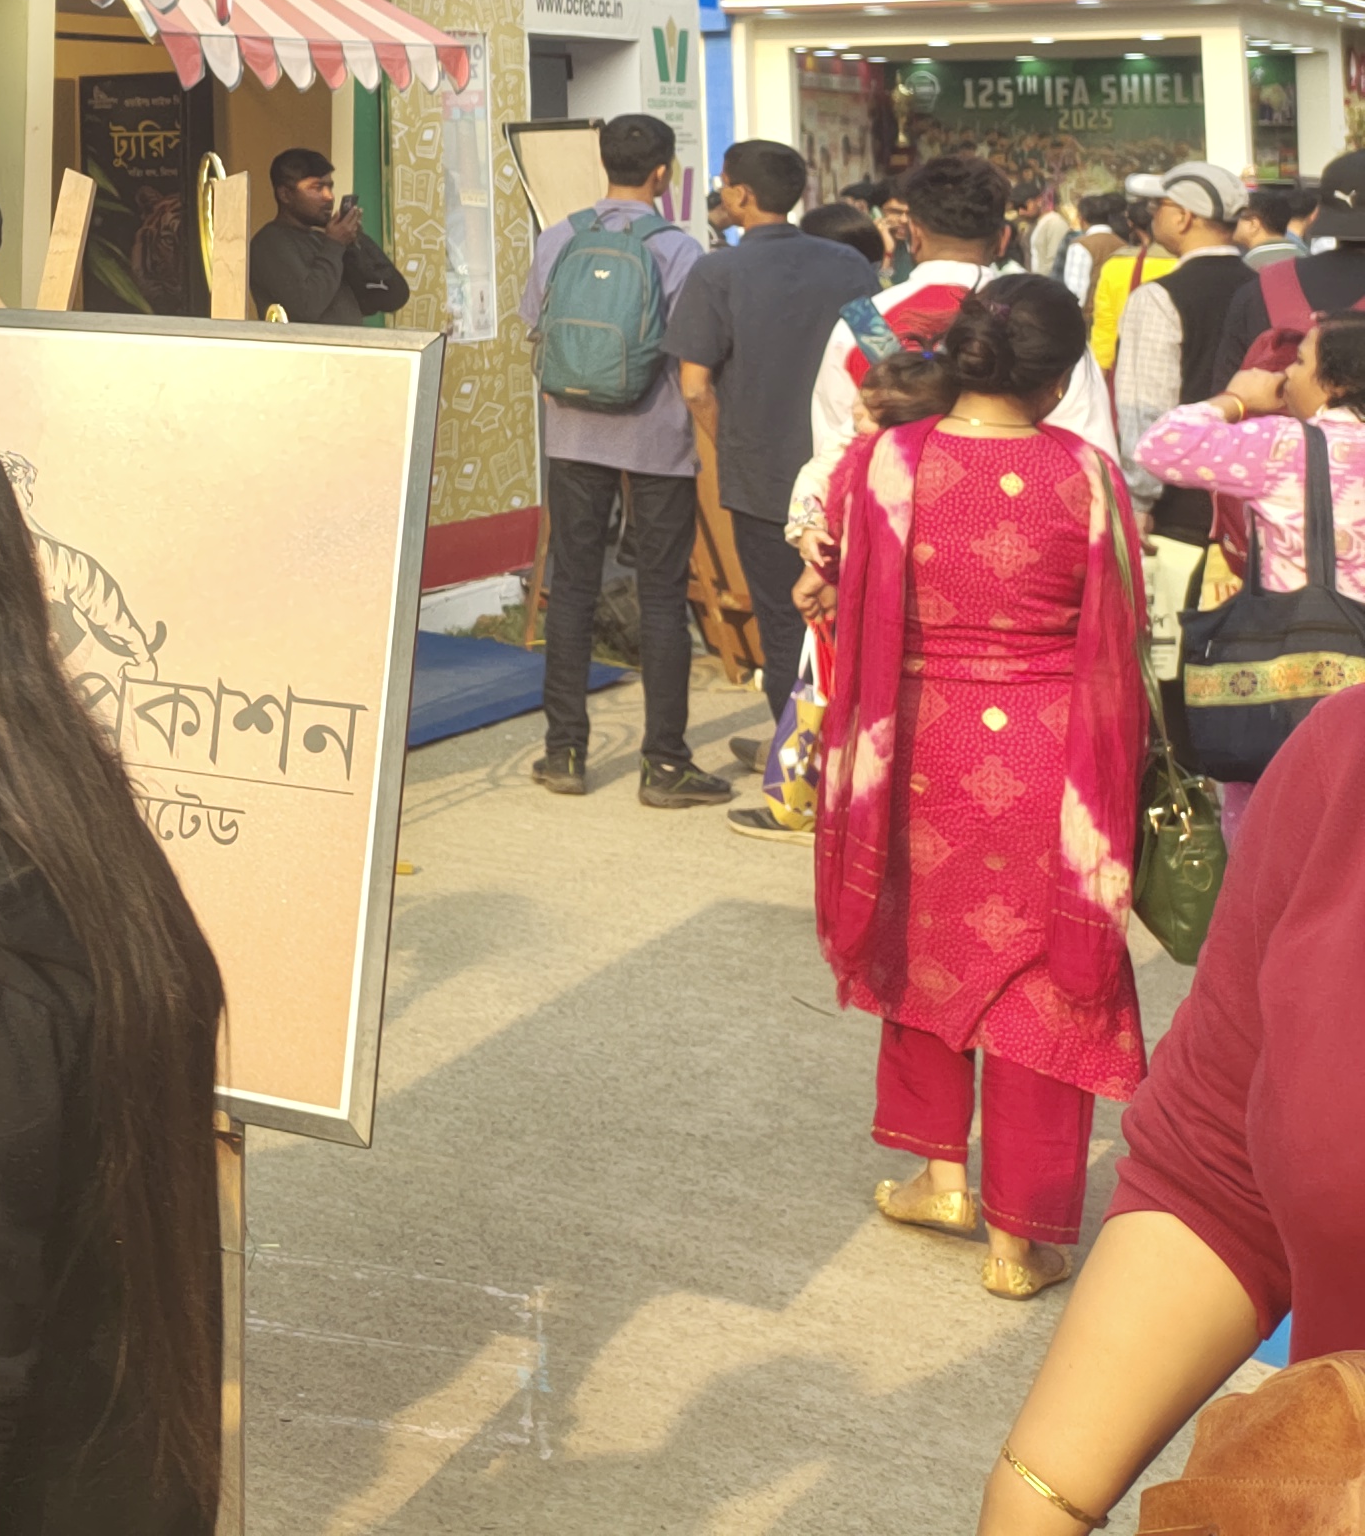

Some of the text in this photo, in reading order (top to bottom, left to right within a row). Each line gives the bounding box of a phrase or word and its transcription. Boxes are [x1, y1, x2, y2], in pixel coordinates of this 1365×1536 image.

[963, 75, 1038, 109] 125TH
[1044, 76, 1090, 108] IFA
[1058, 108, 1114, 132] 2025
